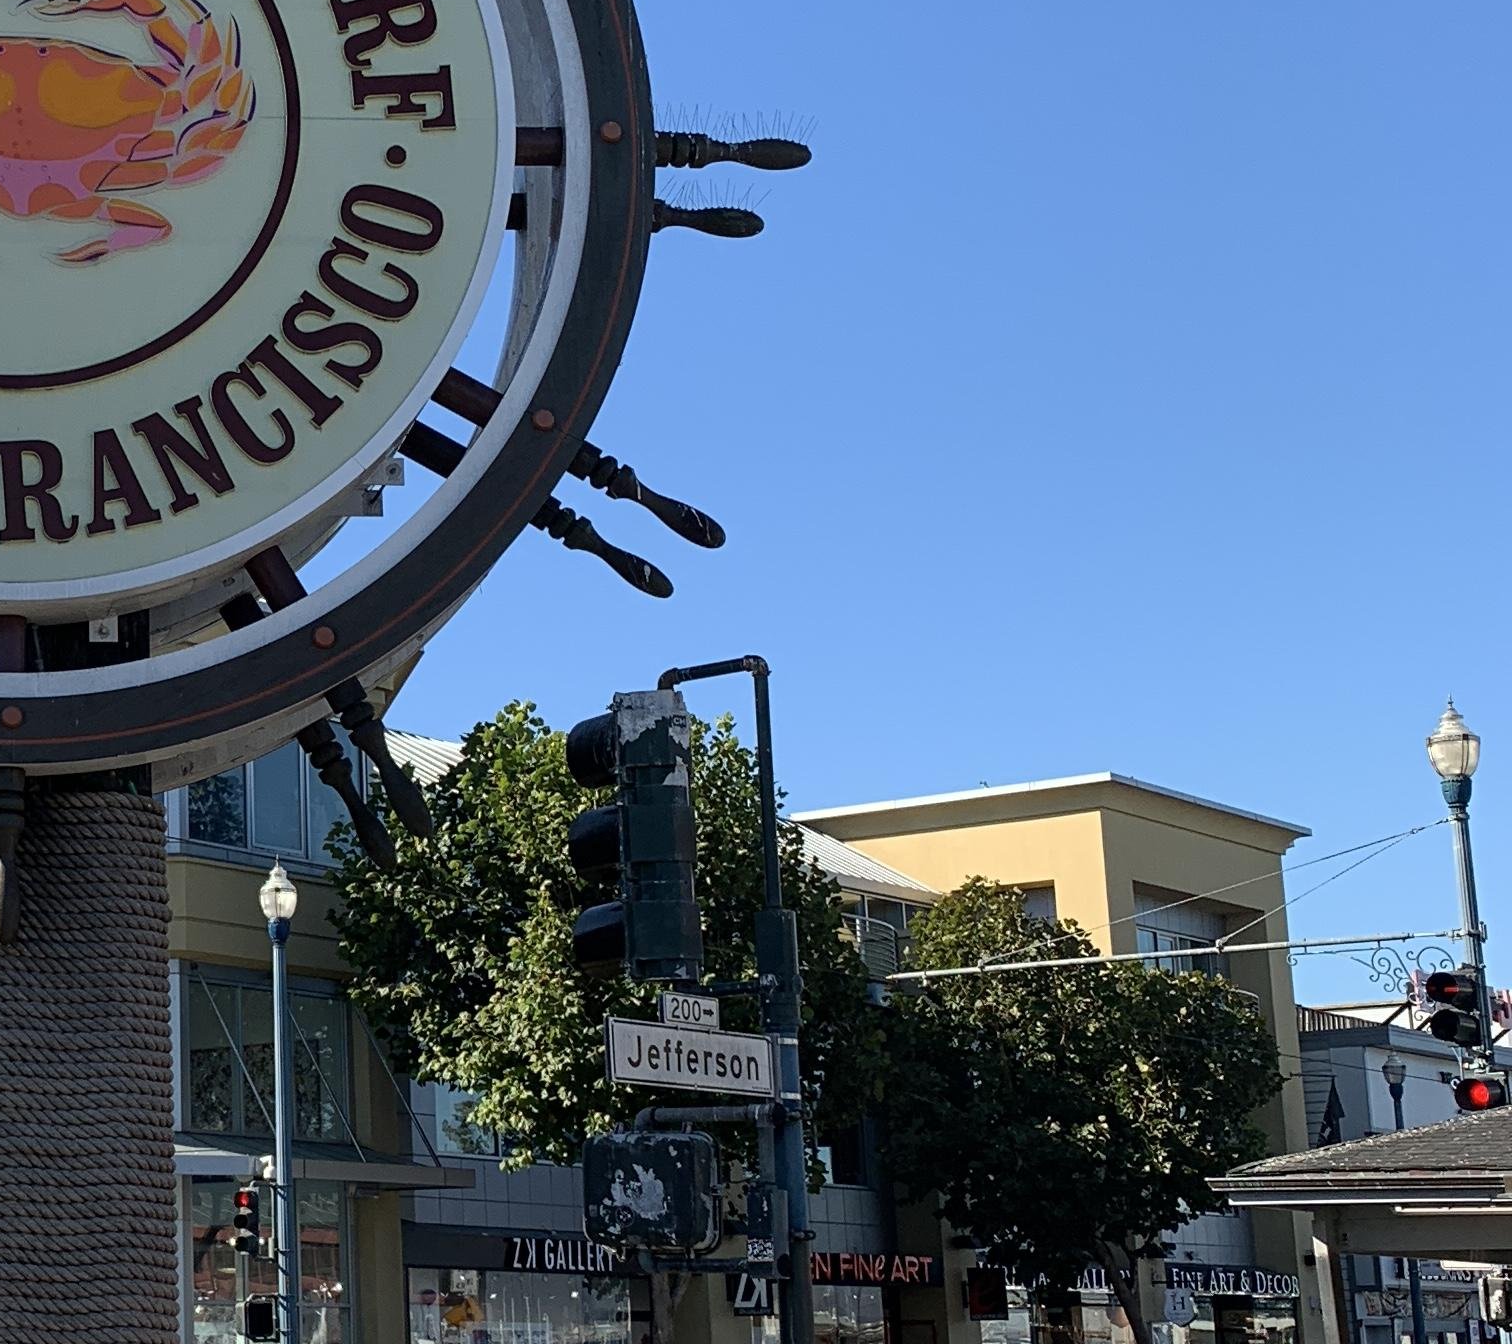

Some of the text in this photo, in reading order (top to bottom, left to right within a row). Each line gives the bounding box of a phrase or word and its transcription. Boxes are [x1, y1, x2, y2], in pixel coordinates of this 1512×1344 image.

[671, 997, 701, 1022] 200
[627, 1035, 759, 1081] Jefferson
[545, 1239, 614, 1271] GALLERY
[891, 1255, 933, 1284] ART
[1172, 1268, 1300, 1296] FINE ART & DECOR
